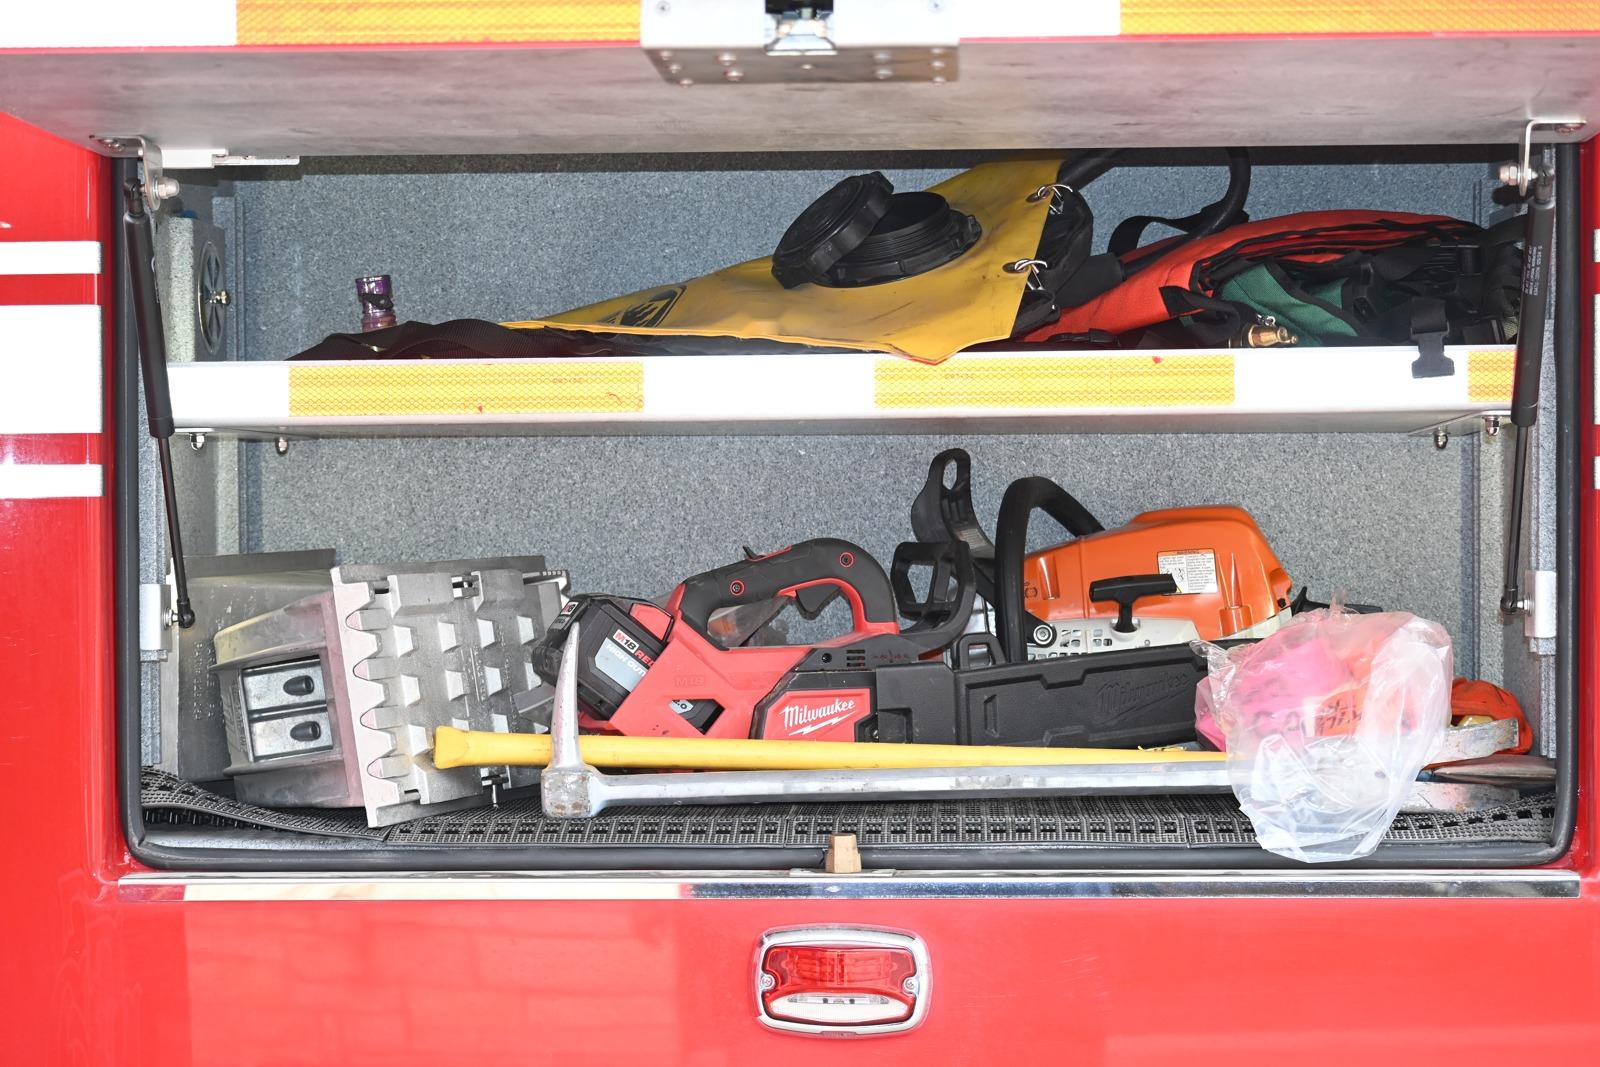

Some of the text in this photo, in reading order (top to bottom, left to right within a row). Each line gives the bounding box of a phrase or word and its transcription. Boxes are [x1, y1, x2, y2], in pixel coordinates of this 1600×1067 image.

[614, 631, 638, 651] M18
[604, 643, 629, 662] HIGH
[779, 698, 856, 730] Milwaukee
